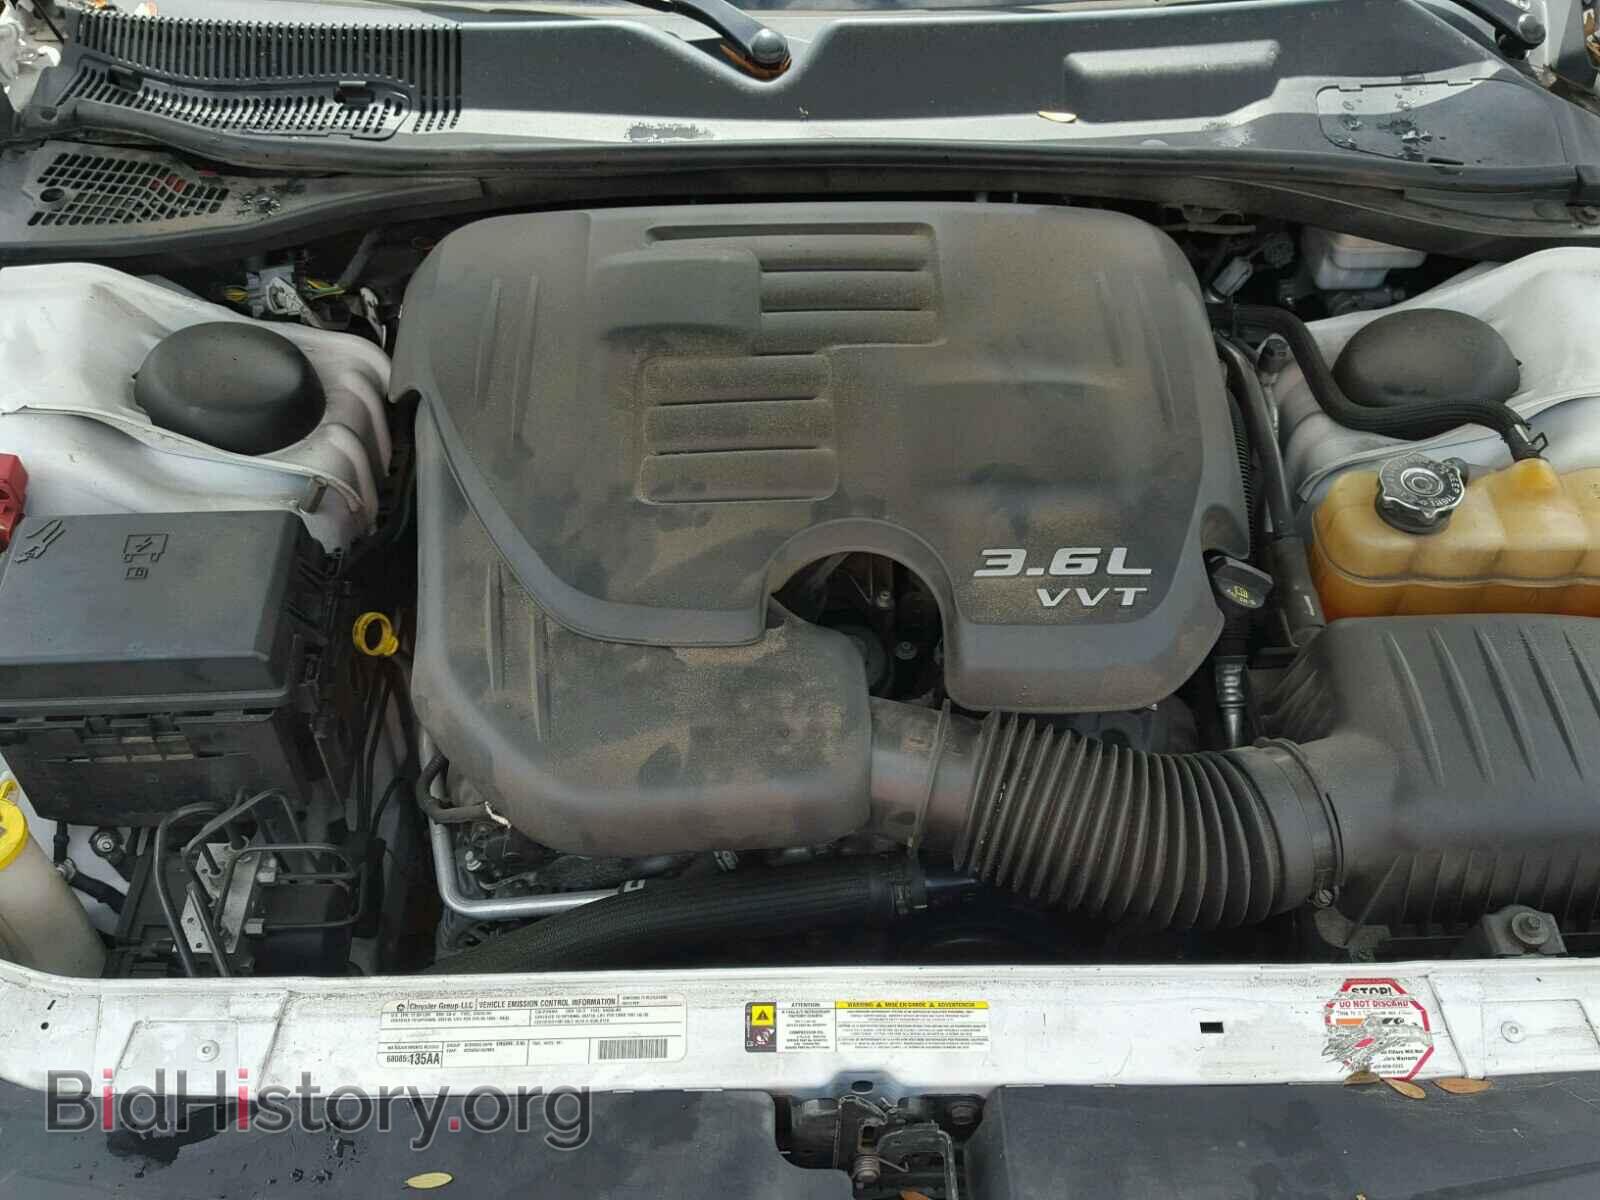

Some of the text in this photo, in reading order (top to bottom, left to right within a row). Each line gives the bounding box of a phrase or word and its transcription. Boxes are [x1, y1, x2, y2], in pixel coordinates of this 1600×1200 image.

[974, 547, 1152, 577] 3.6L
[1036, 587, 1148, 607] VVT
[410, 1001, 474, 1010] Chrysler Group LLC
[479, 1001, 506, 1009] VEHICLE
[507, 1000, 538, 1008] EMISSION
[540, 999, 569, 1007] CONTROL
[571, 998, 616, 1006] INFORMATION
[1353, 1000, 1371, 1008] NOT
[1372, 1000, 1409, 1008] DISCARD
